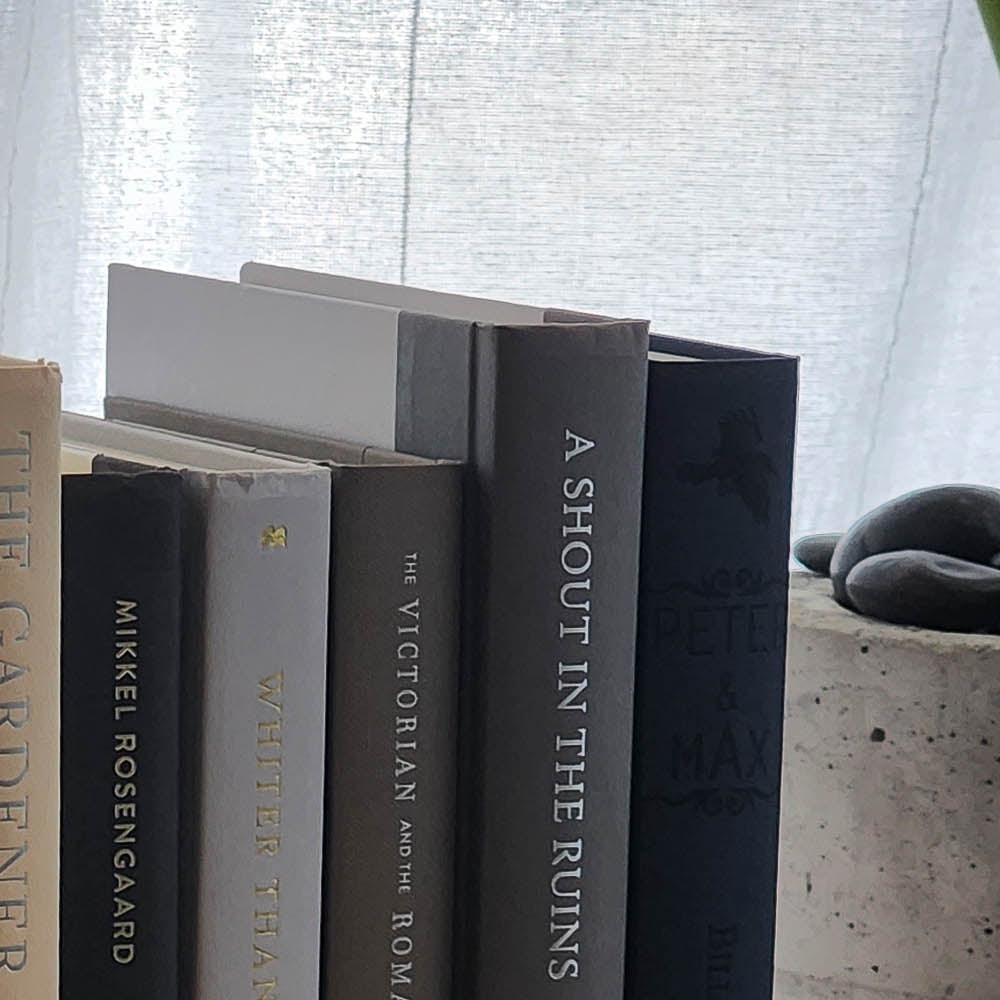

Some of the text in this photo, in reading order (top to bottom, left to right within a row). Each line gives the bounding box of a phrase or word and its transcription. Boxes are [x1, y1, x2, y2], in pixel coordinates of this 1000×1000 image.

[403, 552, 418, 585] THE
[393, 598, 420, 802] VICTORIAN
[547, 429, 595, 981] A SHOUT IN THE RUINS
[670, 720, 771, 782] MAX
[112, 599, 138, 965] MIKKEL ROSENGAARD
[255, 669, 284, 857] WHITER
[398, 819, 413, 858] AND
[398, 861, 412, 894] THE
